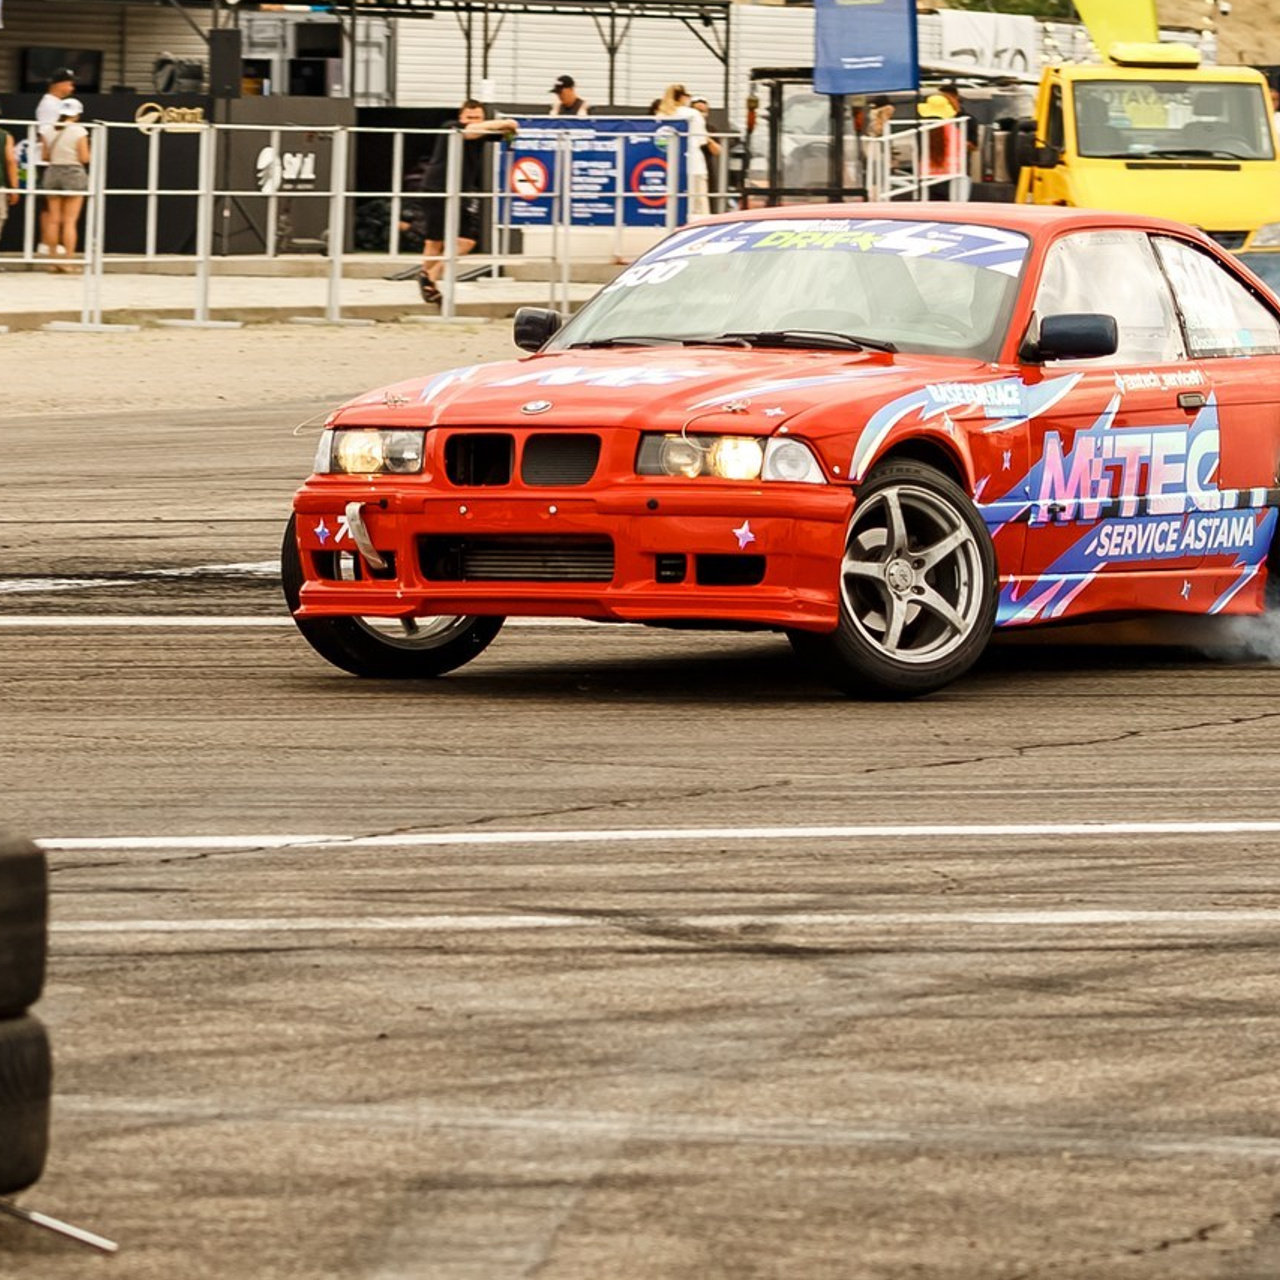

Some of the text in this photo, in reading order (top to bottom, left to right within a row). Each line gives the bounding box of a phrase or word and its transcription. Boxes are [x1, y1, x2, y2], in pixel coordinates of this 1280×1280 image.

[752, 230, 882, 251] DRIFT
[1096, 516, 1254, 556] SERVICE ASTANA
